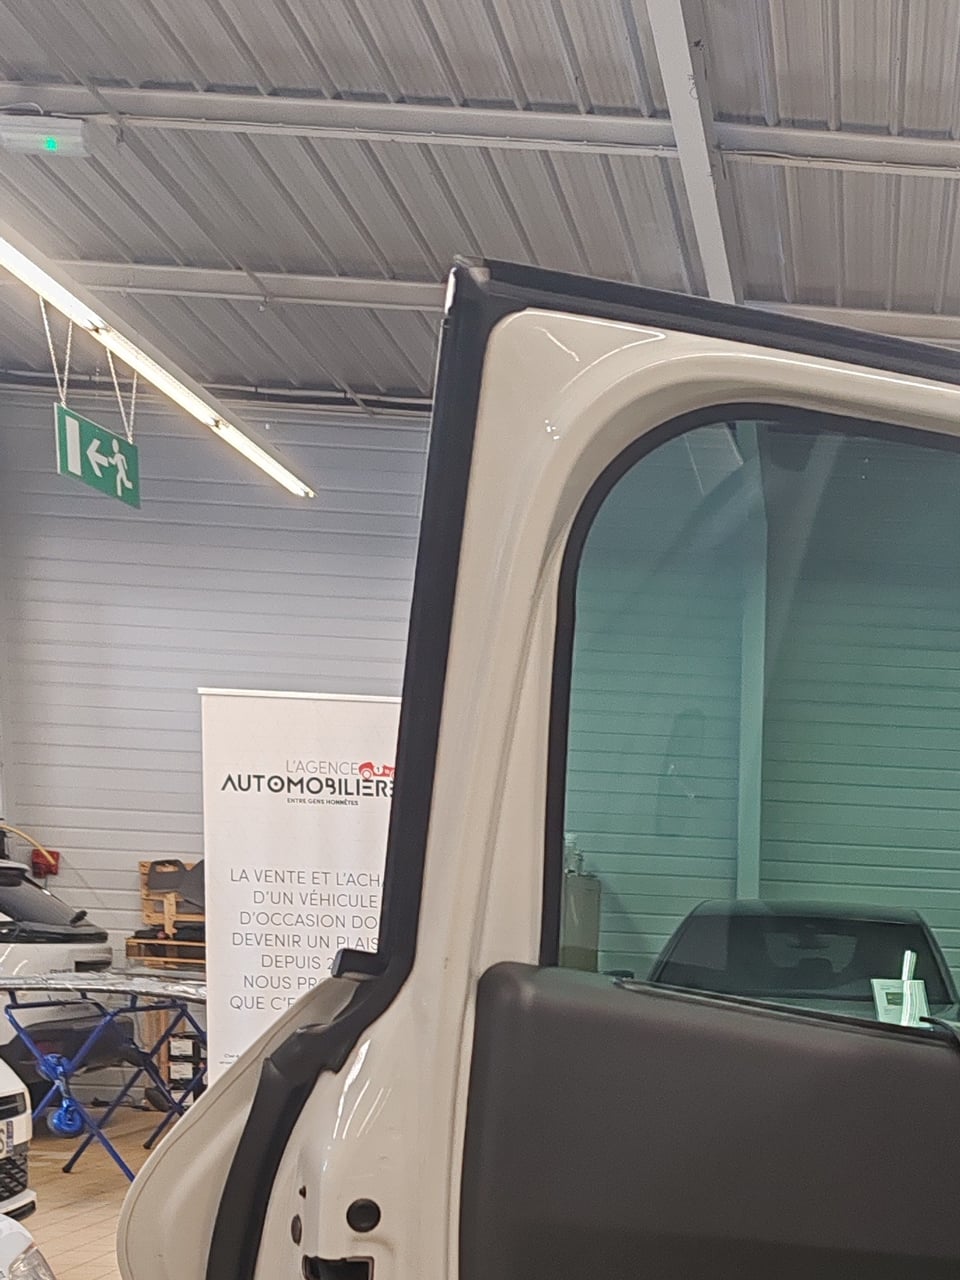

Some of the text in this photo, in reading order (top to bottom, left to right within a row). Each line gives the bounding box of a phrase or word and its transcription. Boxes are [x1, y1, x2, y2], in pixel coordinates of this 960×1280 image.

[286, 760, 359, 776] L'AGENCE
[230, 868, 384, 888] LA VENTE ET L'ACH
[253, 889, 378, 908] D'UN VÉHICULE
[240, 911, 346, 929] D'OCCASION
[232, 932, 302, 948] DEVENIR
[307, 935, 330, 949] UN
[261, 954, 321, 970] DEPUIS
[243, 975, 292, 990] NOUS
[230, 995, 265, 1010] QUE
